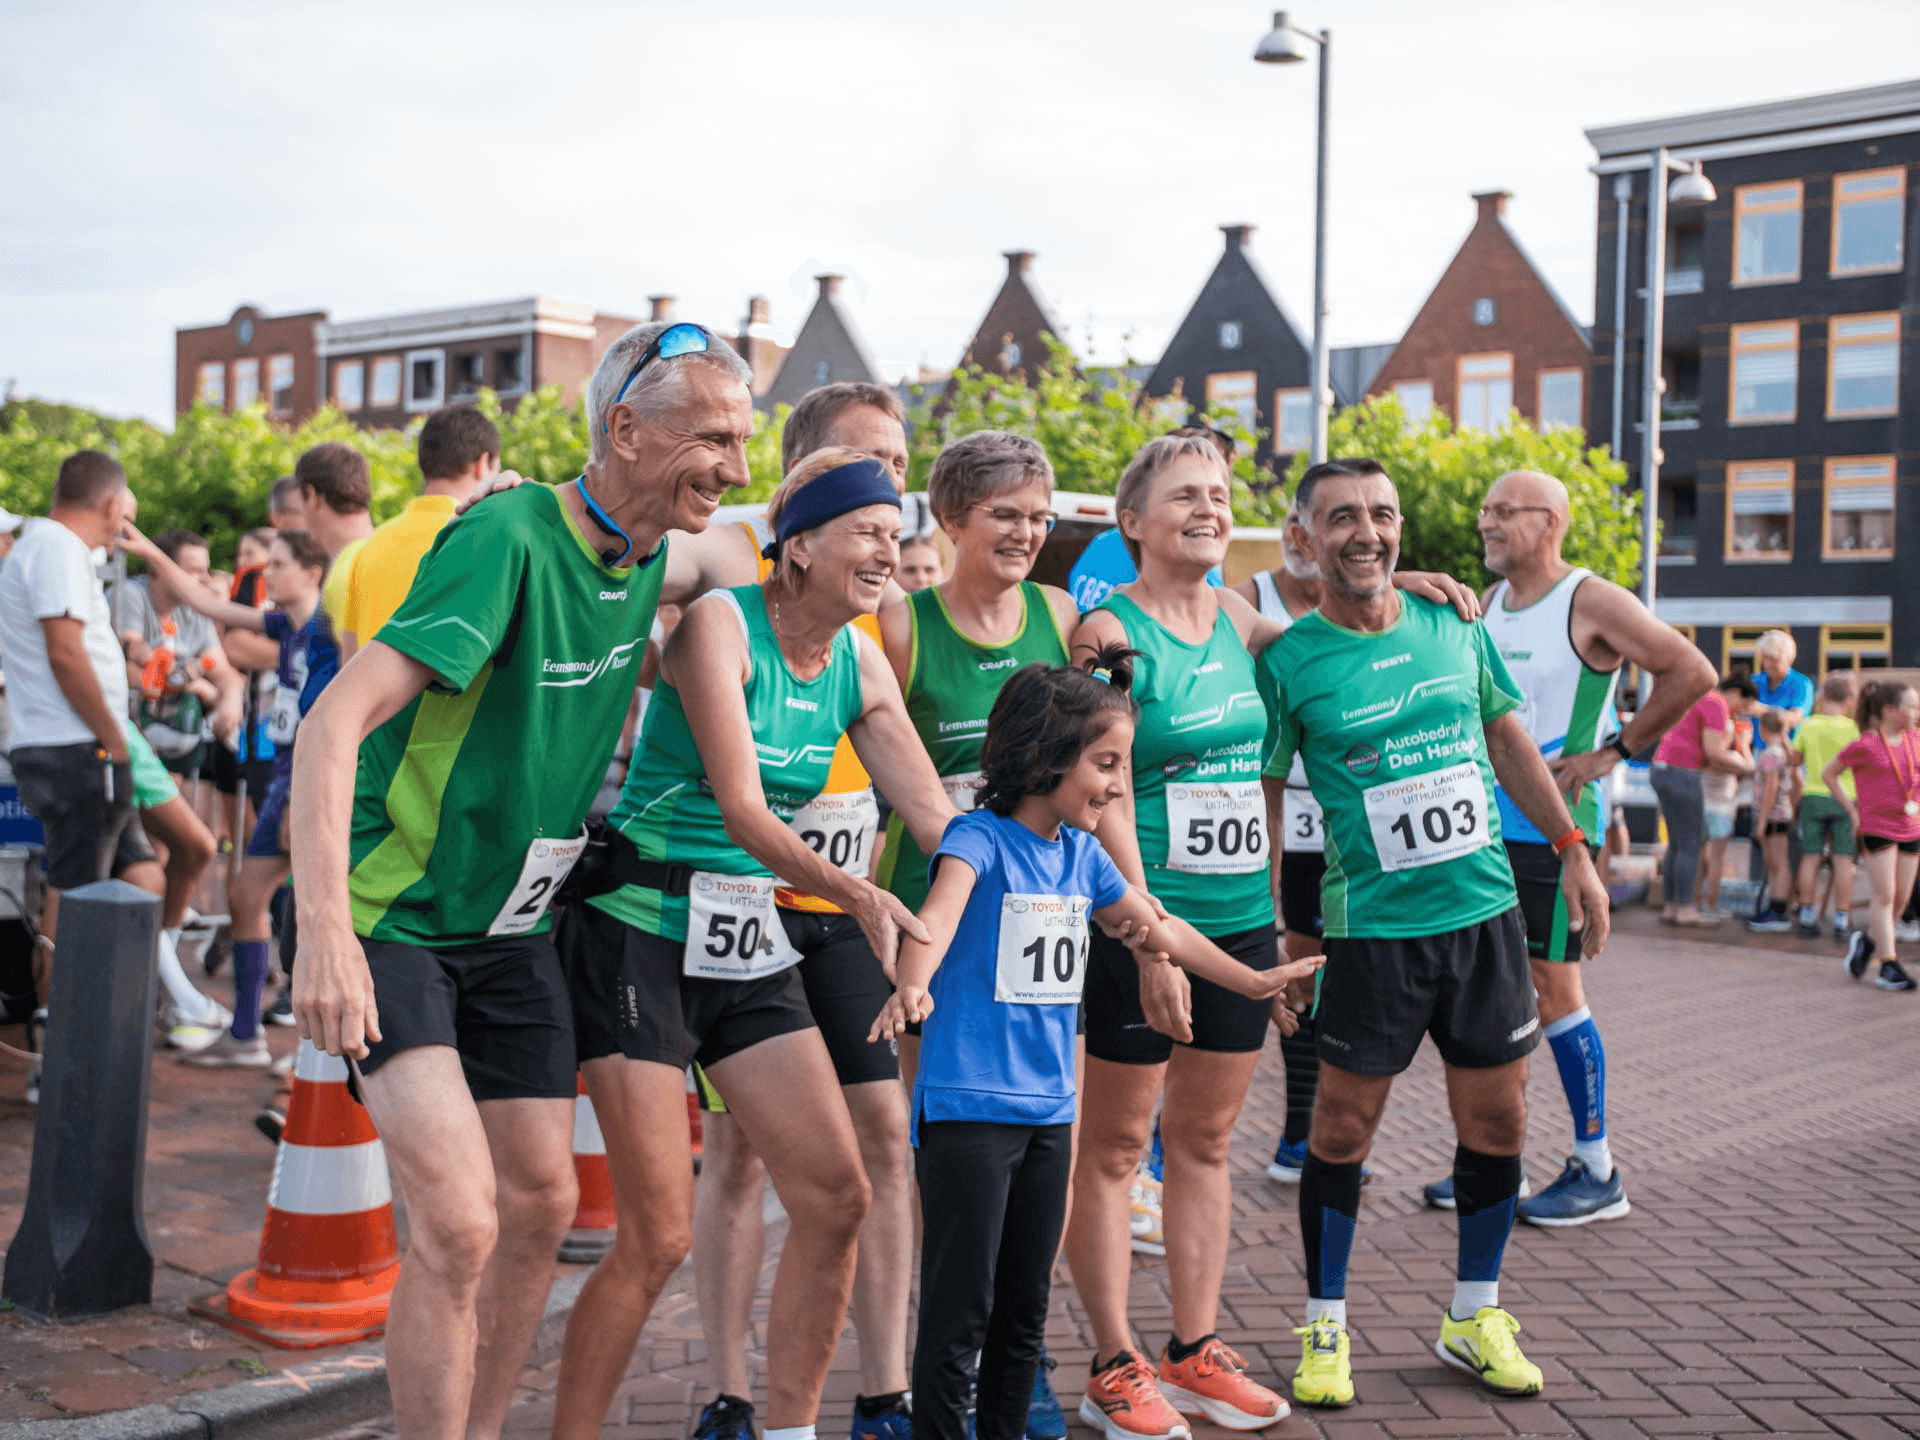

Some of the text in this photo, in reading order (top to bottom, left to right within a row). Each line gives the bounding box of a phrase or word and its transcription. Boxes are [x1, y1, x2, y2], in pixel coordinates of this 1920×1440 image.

[543, 658, 595, 673] Eemsmond
[1341, 695, 1396, 721] Eemsmond
[939, 718, 988, 733] Eemsmo
[1384, 719, 1461, 753] Autobedrijf
[1198, 761, 1228, 775] Den
[1388, 751, 1424, 770] Den
[1386, 767, 1477, 798] TOYOTA LANTINGA
[1190, 789, 1230, 799] TOYOTA
[1403, 785, 1456, 805] UITHUIZEN
[1391, 799, 1477, 851] 103
[1186, 816, 1262, 857] 506
[716, 881, 758, 894] TOYOTA
[1032, 902, 1064, 913] TOYOTA
[627, 985, 639, 1018] CRAFT
